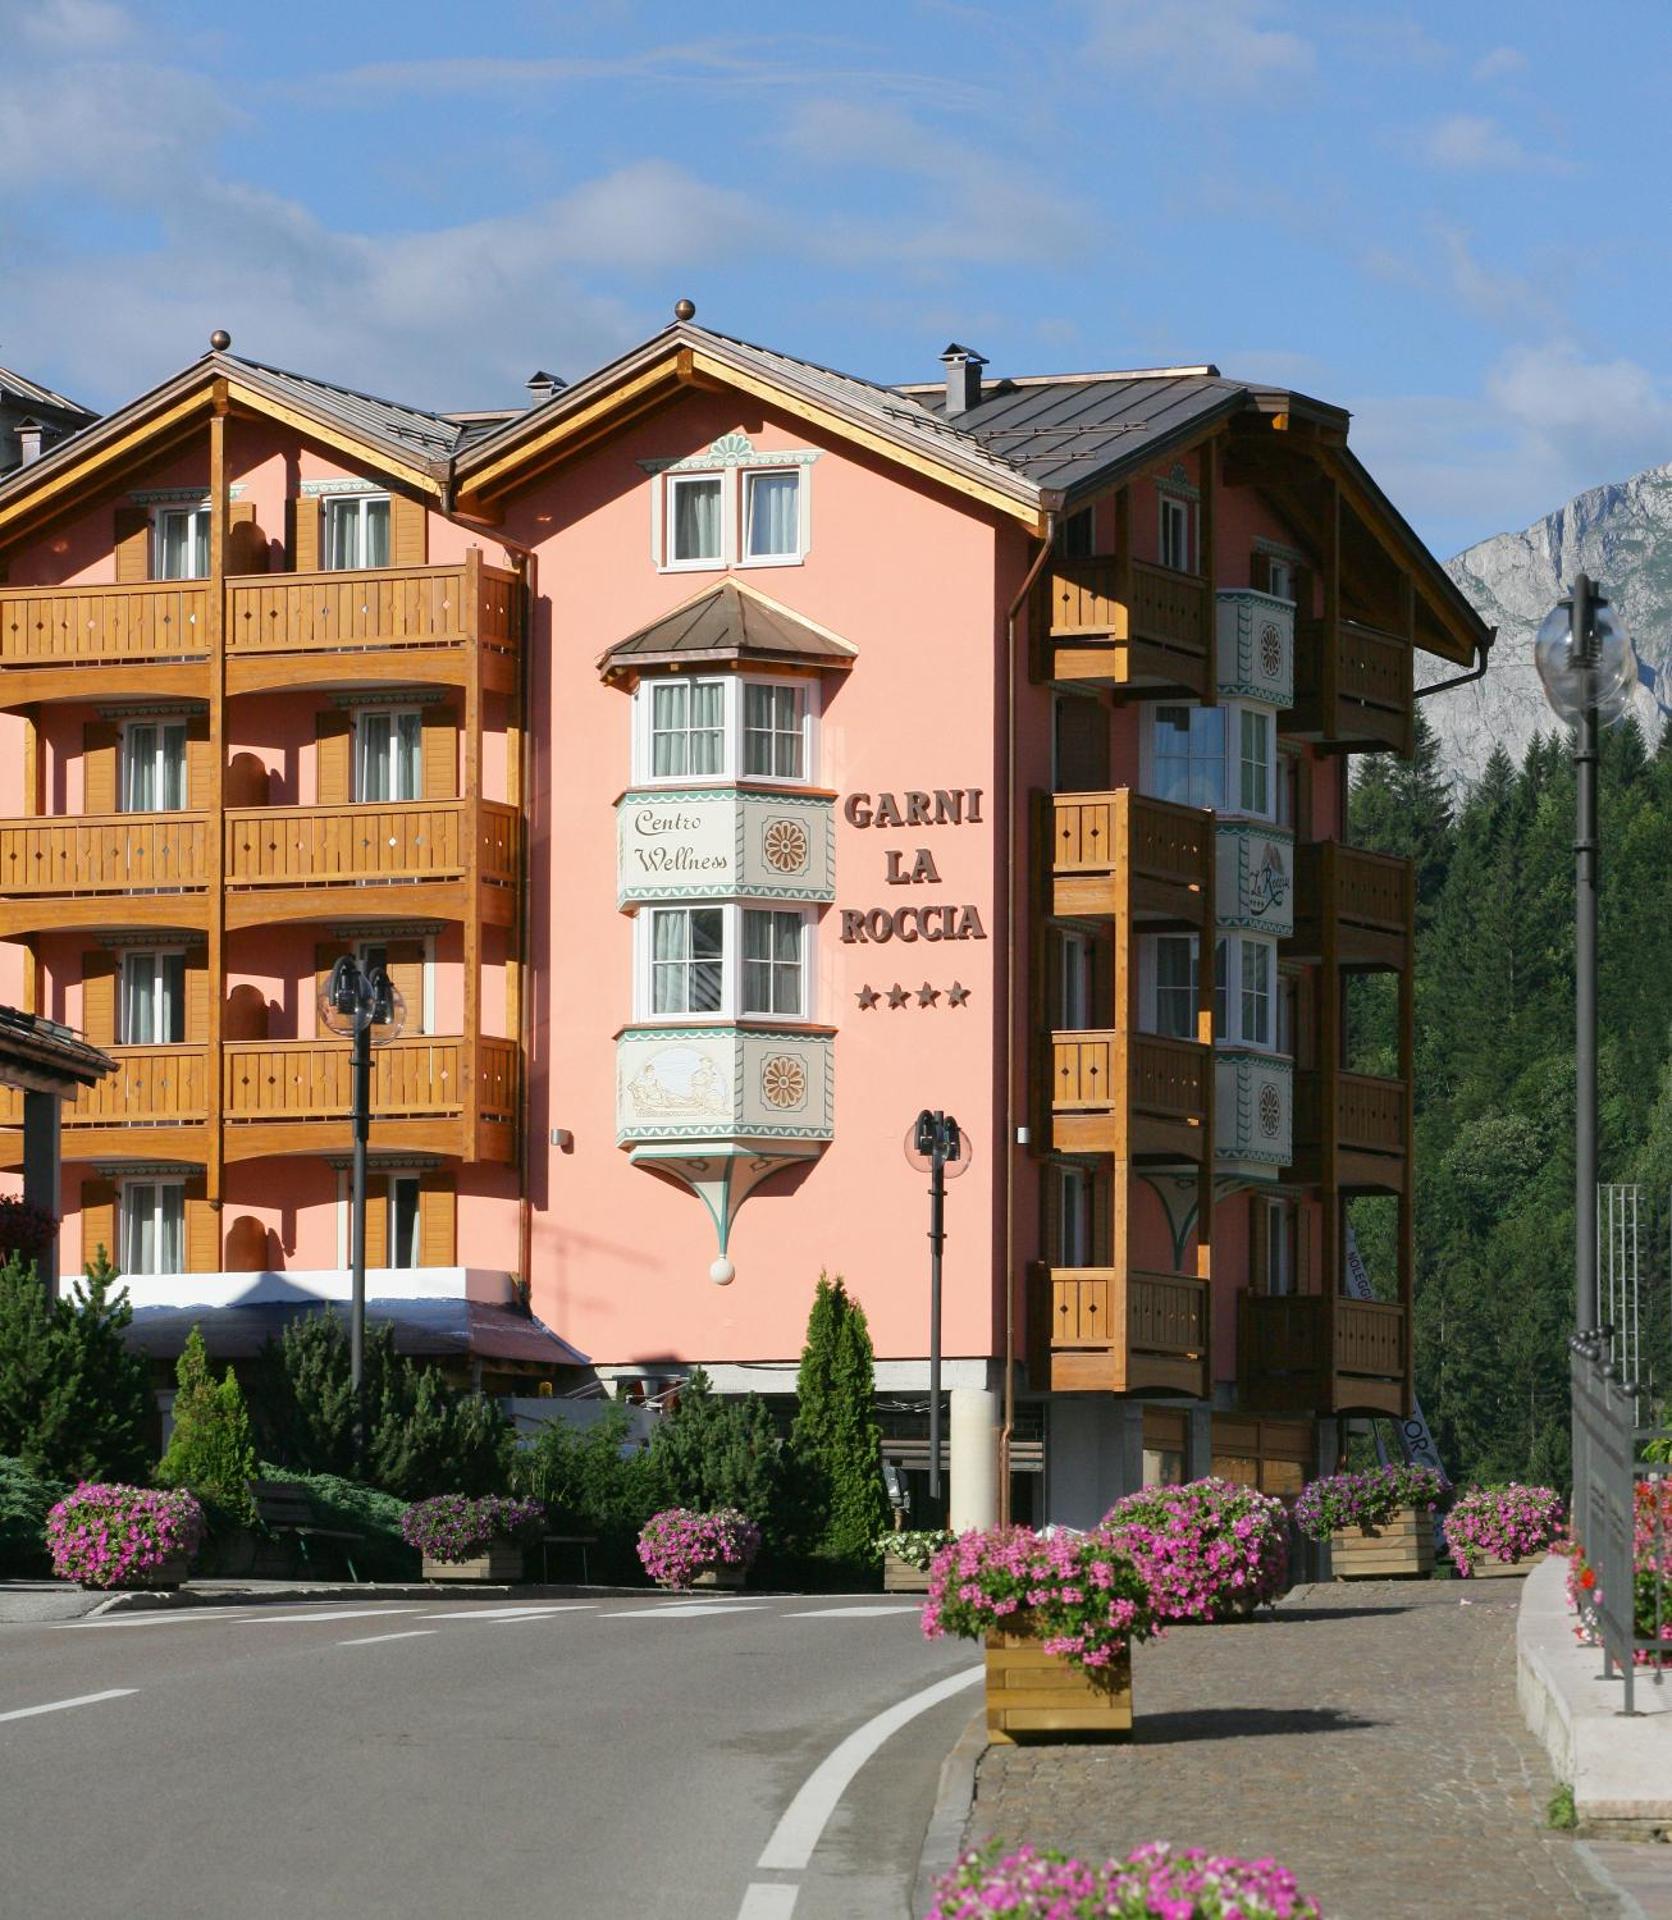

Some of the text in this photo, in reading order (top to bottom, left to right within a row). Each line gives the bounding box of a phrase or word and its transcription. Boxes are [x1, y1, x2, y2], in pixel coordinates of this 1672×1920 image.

[635, 809, 701, 836] Centro
[844, 788, 984, 829] GARNI
[634, 846, 728, 872] Wellness
[884, 848, 943, 885] LA
[839, 905, 988, 944] ROCCIA
